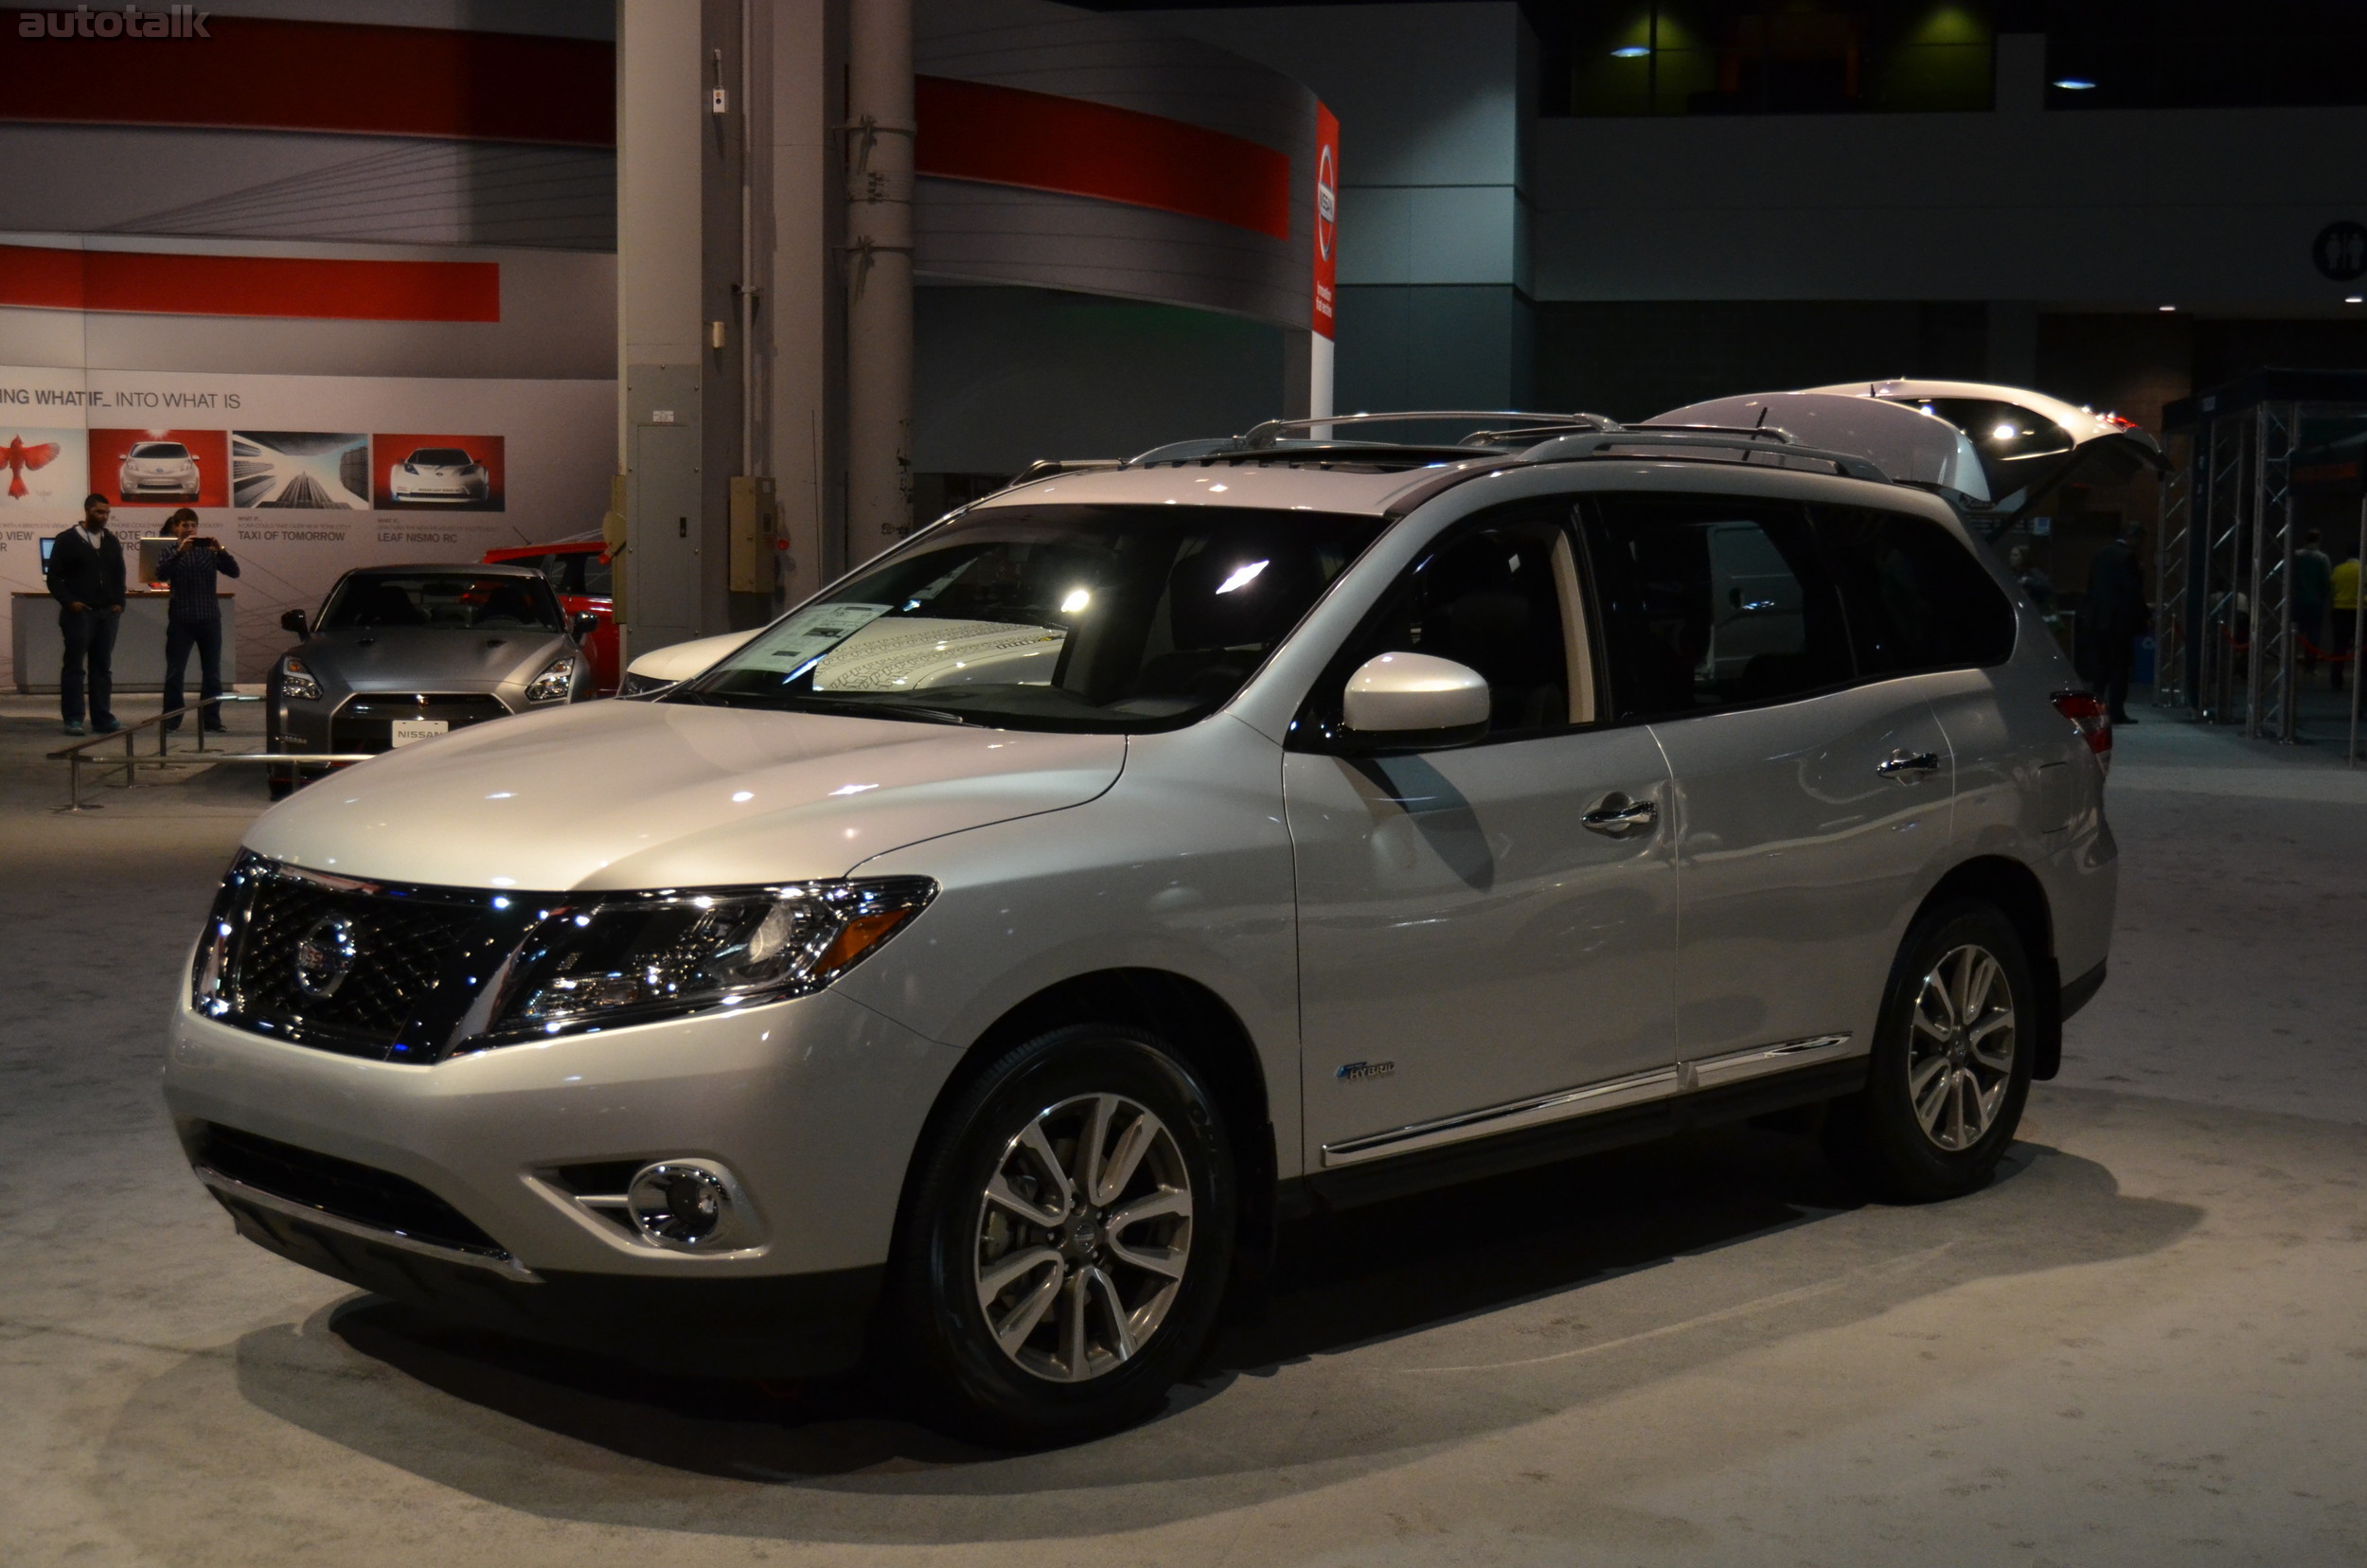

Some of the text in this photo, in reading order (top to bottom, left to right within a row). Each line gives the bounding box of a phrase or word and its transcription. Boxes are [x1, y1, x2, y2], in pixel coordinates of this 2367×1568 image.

[35, 390, 86, 406] WHAT
[116, 392, 159, 407] INTO
[162, 393, 218, 408] WHAT
[224, 394, 240, 409] IS
[238, 530, 346, 542] TAXI OF TOMORROW
[377, 532, 458, 543] LEAF NISMO RC
